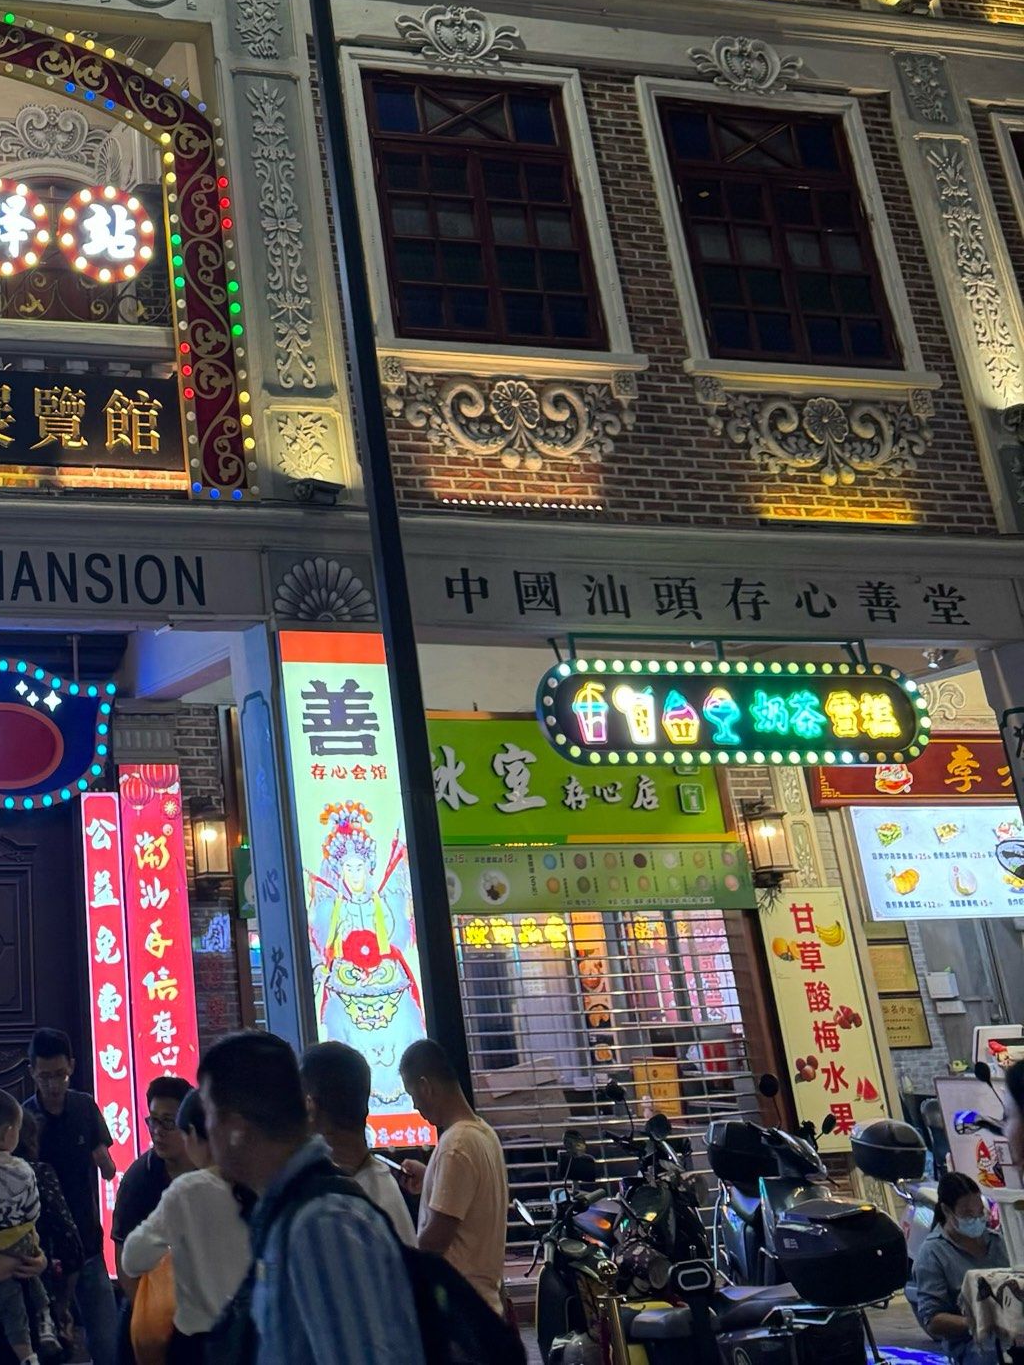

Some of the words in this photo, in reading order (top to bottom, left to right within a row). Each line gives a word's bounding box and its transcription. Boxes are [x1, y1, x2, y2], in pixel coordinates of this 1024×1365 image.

[445, 567, 971, 626] 中國汕頭存心善堂
[301, 679, 380, 757] 善
[310, 763, 388, 781] 存心会馆
[562, 775, 660, 810] 存心店
[86, 818, 131, 1145] 公益免费电影
[134, 831, 180, 1077] 潮汕手信存心
[790, 902, 856, 1136] 甘草酸梅水果
